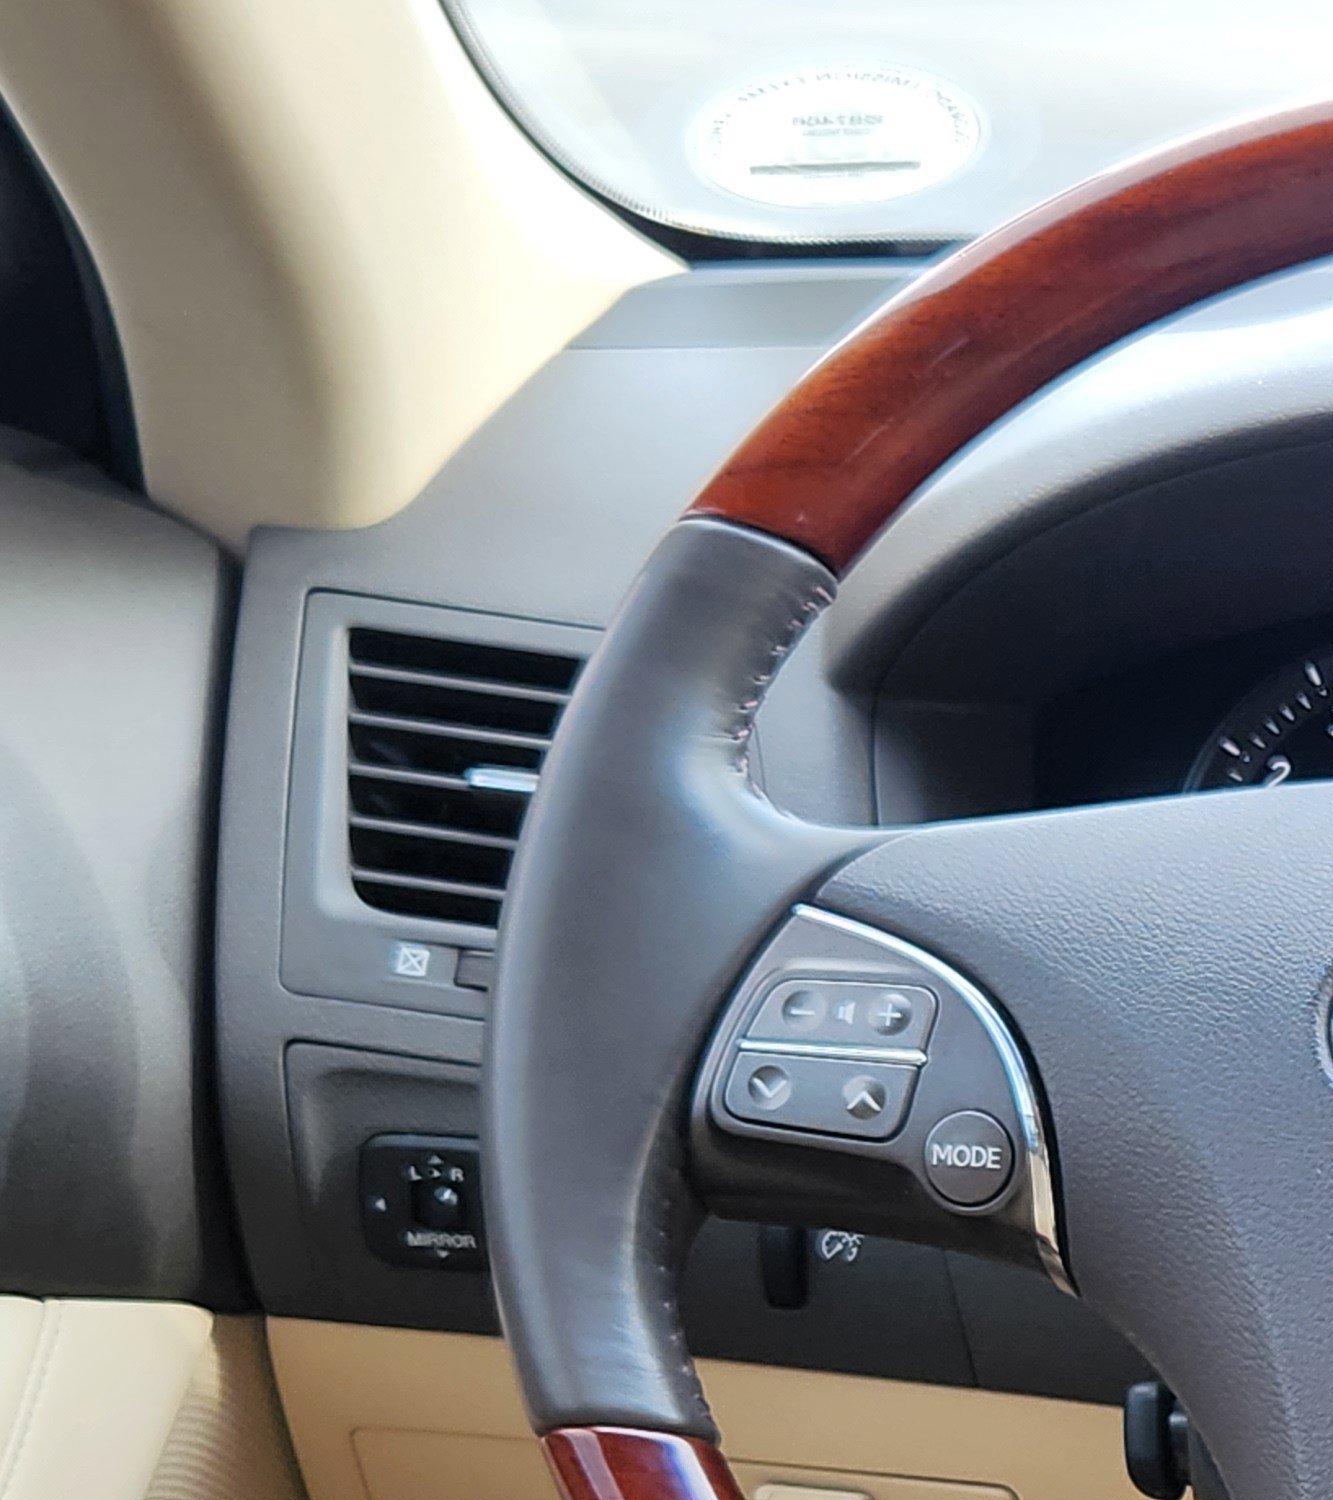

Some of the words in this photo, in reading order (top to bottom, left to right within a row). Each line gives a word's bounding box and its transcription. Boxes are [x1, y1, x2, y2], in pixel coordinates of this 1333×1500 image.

[930, 1143, 1003, 1171] MODE
[408, 1166, 423, 1181] L
[451, 1167, 465, 1182] R
[406, 1230, 477, 1250] MIRROR
